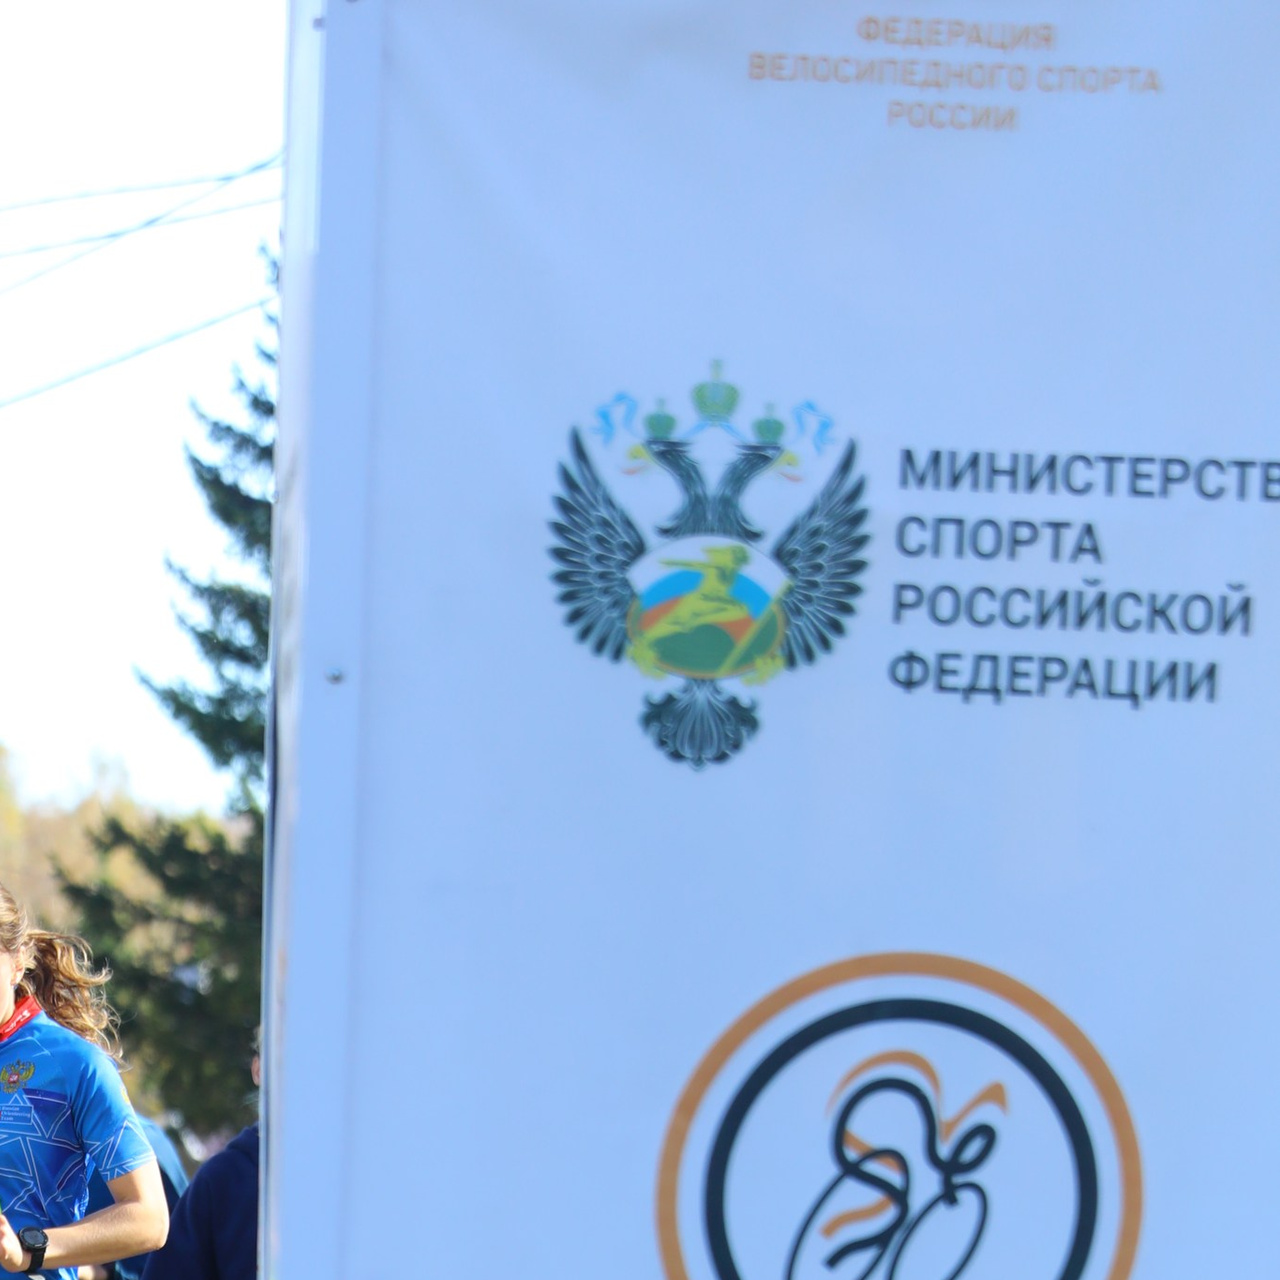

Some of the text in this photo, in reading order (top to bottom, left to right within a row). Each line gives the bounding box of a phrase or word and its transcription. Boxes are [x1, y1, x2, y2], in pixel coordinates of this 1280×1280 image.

[856, 16, 1056, 51] ФЕДЕРАЦИЯ
[748, 52, 1161, 93] ВЕЛОСИПЕДНОГО СПОРТА
[886, 100, 1018, 131] РОССИИ
[894, 515, 1104, 565] СПОРТА
[891, 577, 1253, 638] РОССИЙСКОЙ
[887, 650, 1218, 711] ФЕДЕРАЦИИ
